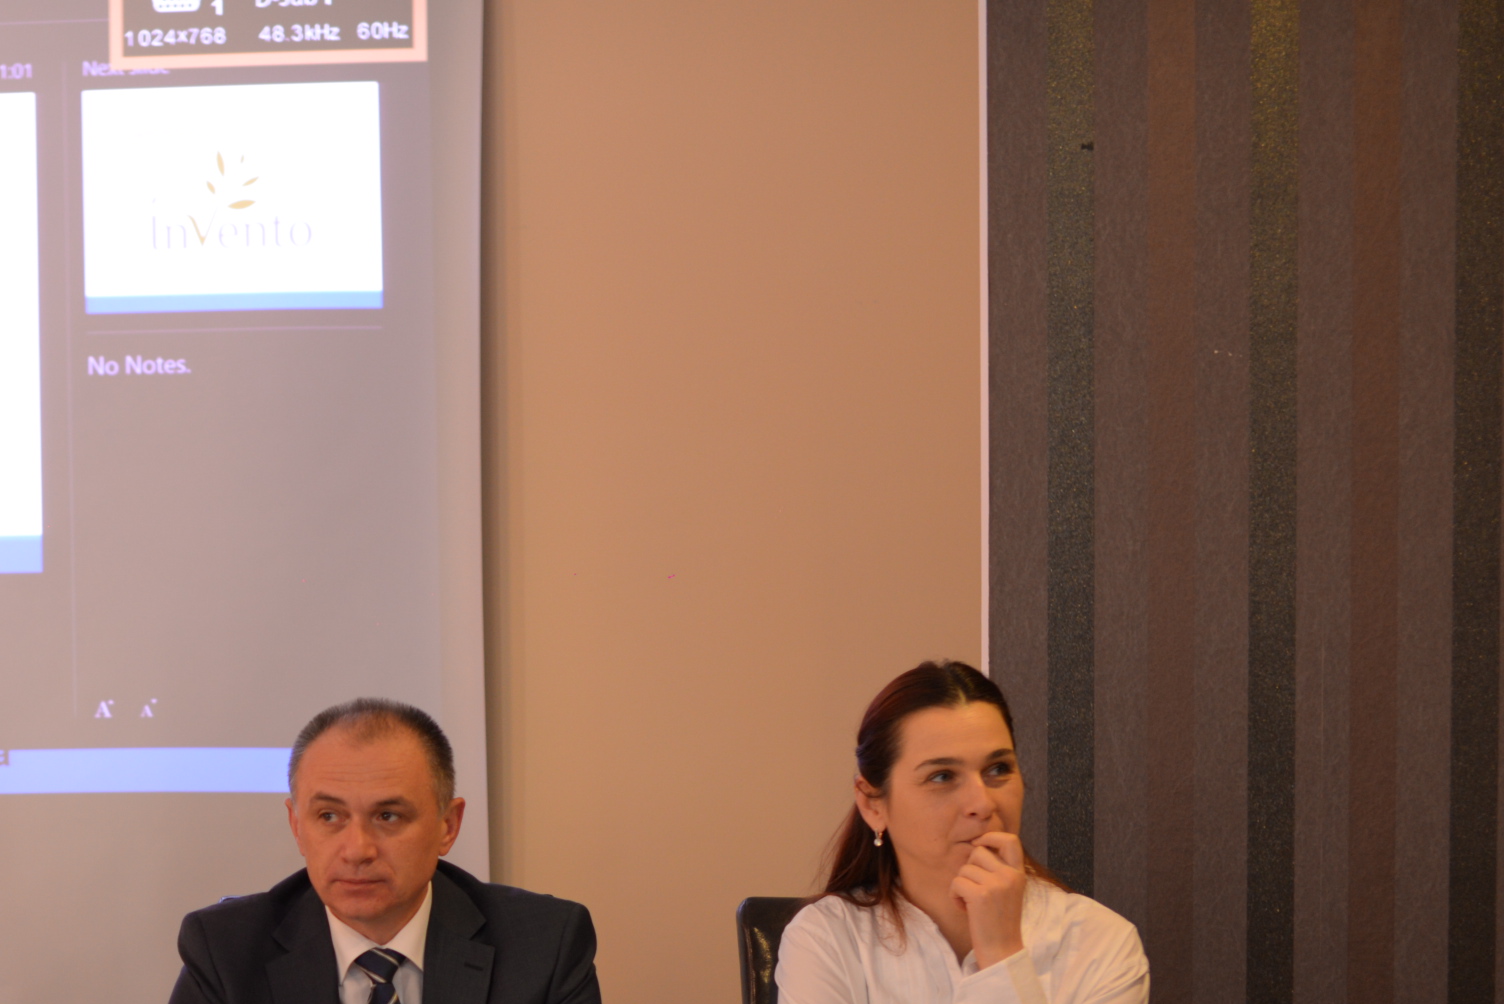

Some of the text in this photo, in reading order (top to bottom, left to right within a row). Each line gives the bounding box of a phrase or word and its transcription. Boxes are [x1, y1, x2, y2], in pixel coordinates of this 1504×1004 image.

[258, 23, 341, 42] 48.3kHz
[356, 21, 409, 40] 60Hz
[87, 354, 191, 376] No Notes.
